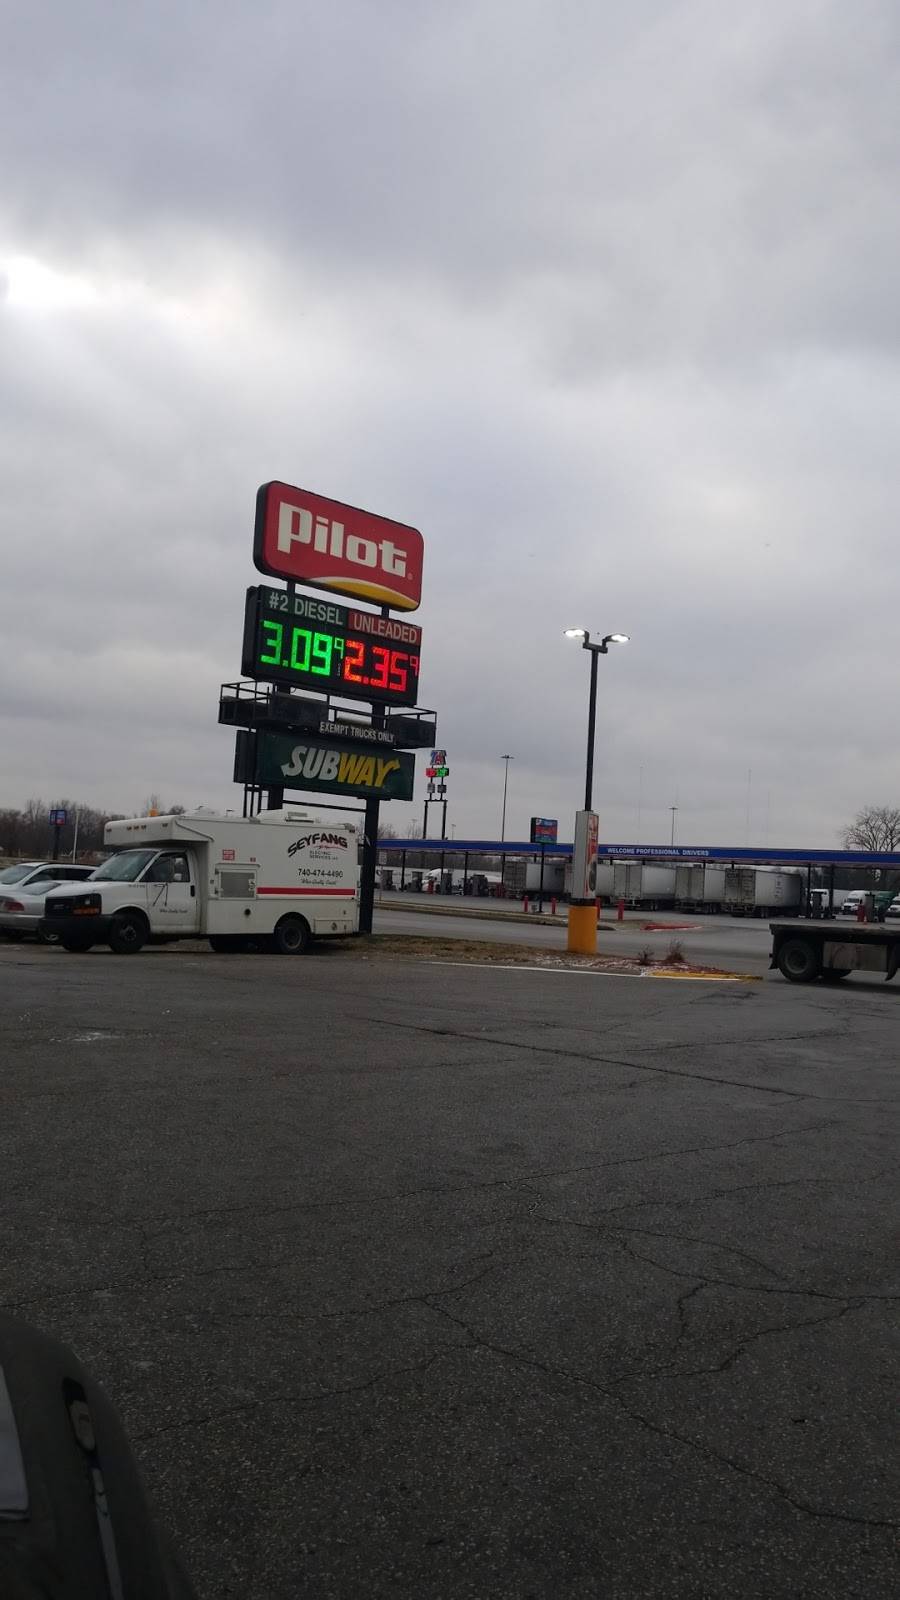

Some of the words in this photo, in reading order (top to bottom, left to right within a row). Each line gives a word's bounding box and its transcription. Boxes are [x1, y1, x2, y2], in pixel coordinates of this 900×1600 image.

[277, 501, 408, 578] Pilot
[269, 591, 289, 612] #2
[294, 598, 344, 626] DIESEL
[353, 612, 418, 644] UNLEADED
[319, 721, 349, 736] EXEMPT
[350, 726, 377, 740] TRUCKS
[377, 731, 395, 743] ONLY
[280, 744, 401, 788] SUBWAY
[287, 832, 348, 858] SEYFANG
[298, 868, 344, 878] 740-474-4490
